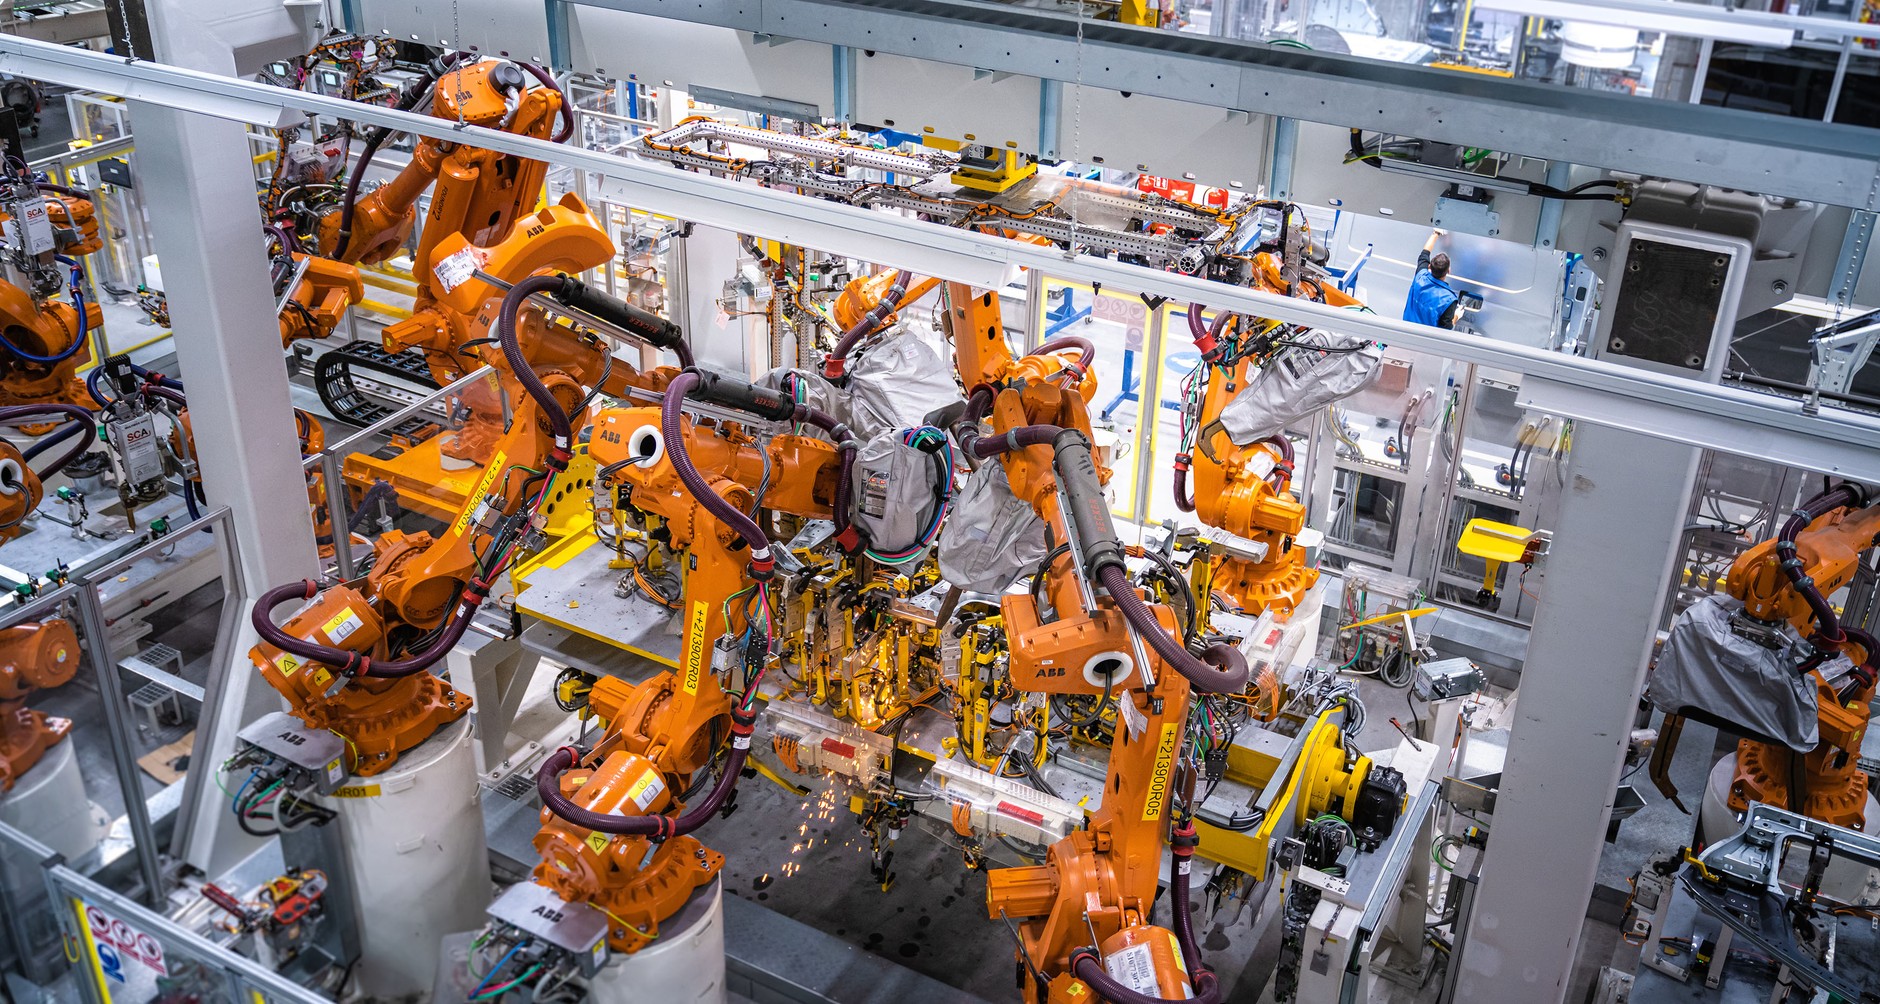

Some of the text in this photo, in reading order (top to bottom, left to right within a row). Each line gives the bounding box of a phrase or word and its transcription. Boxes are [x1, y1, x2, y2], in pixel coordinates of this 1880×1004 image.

[26, 207, 43, 218] SCA
[526, 224, 545, 238] ABB
[478, 314, 490, 327] ABB
[127, 428, 148, 442] SCA
[600, 429, 621, 444] ABB
[457, 459, 501, 531] ++213900R01
[1828, 575, 1842, 591] ABB
[686, 609, 704, 690] ++213900R03
[1035, 667, 1066, 678] ABB
[277, 731, 307, 746] ABB
[1146, 730, 1175, 816] ++213900R05
[531, 905, 564, 923] ABB
